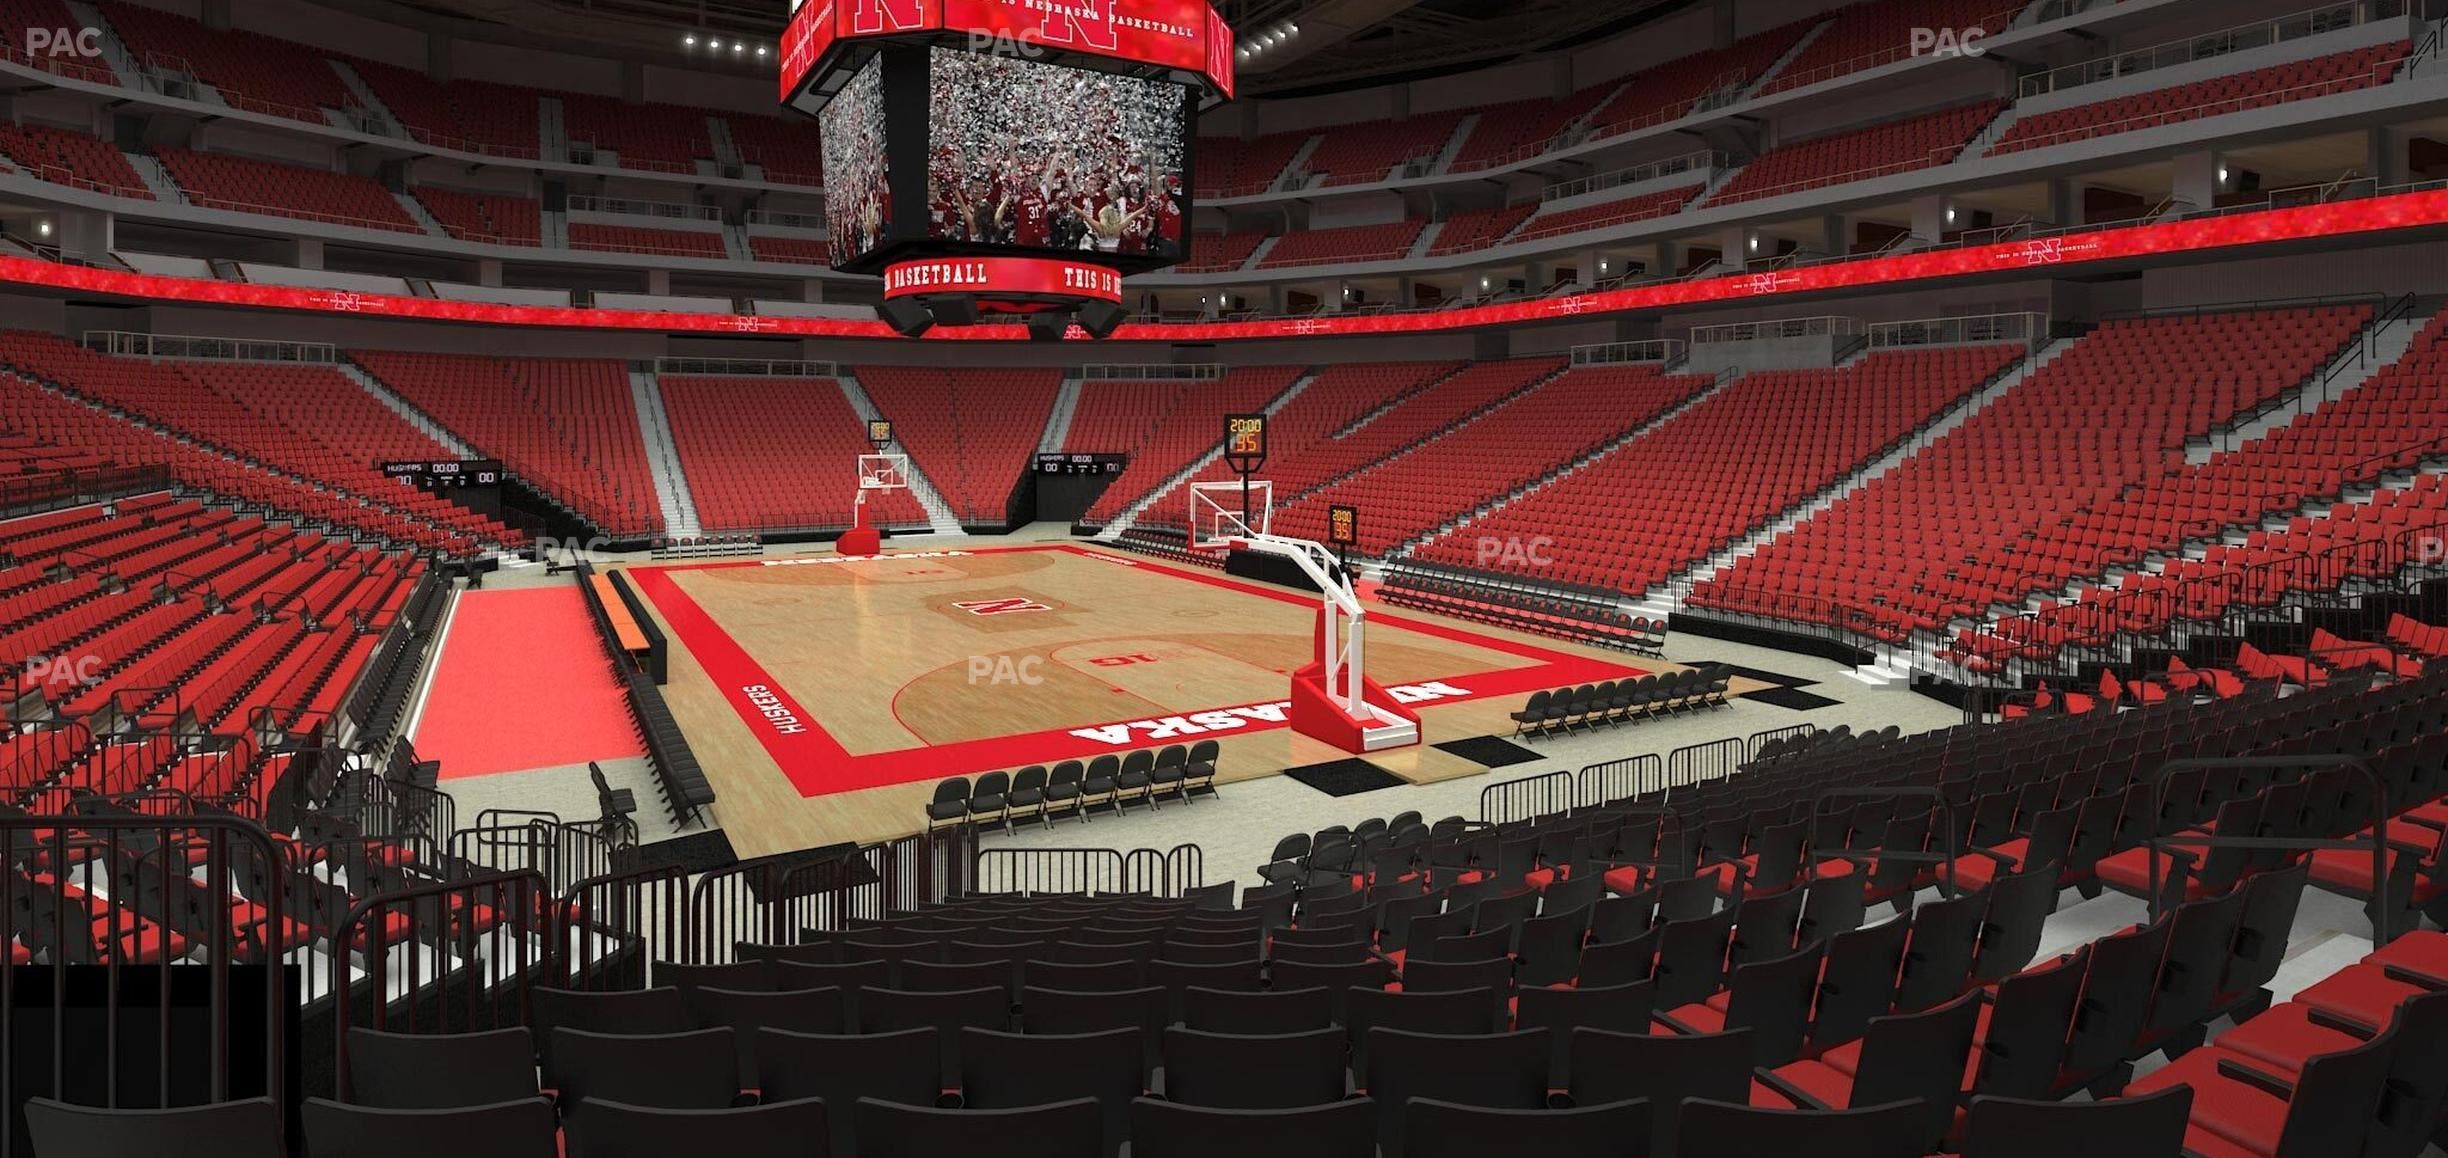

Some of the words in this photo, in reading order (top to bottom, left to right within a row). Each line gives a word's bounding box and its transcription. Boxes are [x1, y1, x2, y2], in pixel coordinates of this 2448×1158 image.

[1108, 14, 1194, 37] BASKETBALL
[1210, 8, 1230, 93] N
[1028, 206, 1040, 219] 31
[2027, 238, 2062, 264] N
[894, 263, 987, 289] BASKETBALL
[1064, 267, 1097, 289] THIS
[1102, 272, 1111, 292] IS
[1753, 272, 1777, 294] N
[335, 293, 360, 311] N
[1230, 418, 1262, 433] 20:00
[432, 463, 460, 473] 00:00
[478, 472, 495, 483] 00
[742, 684, 807, 734] HUSKERS
